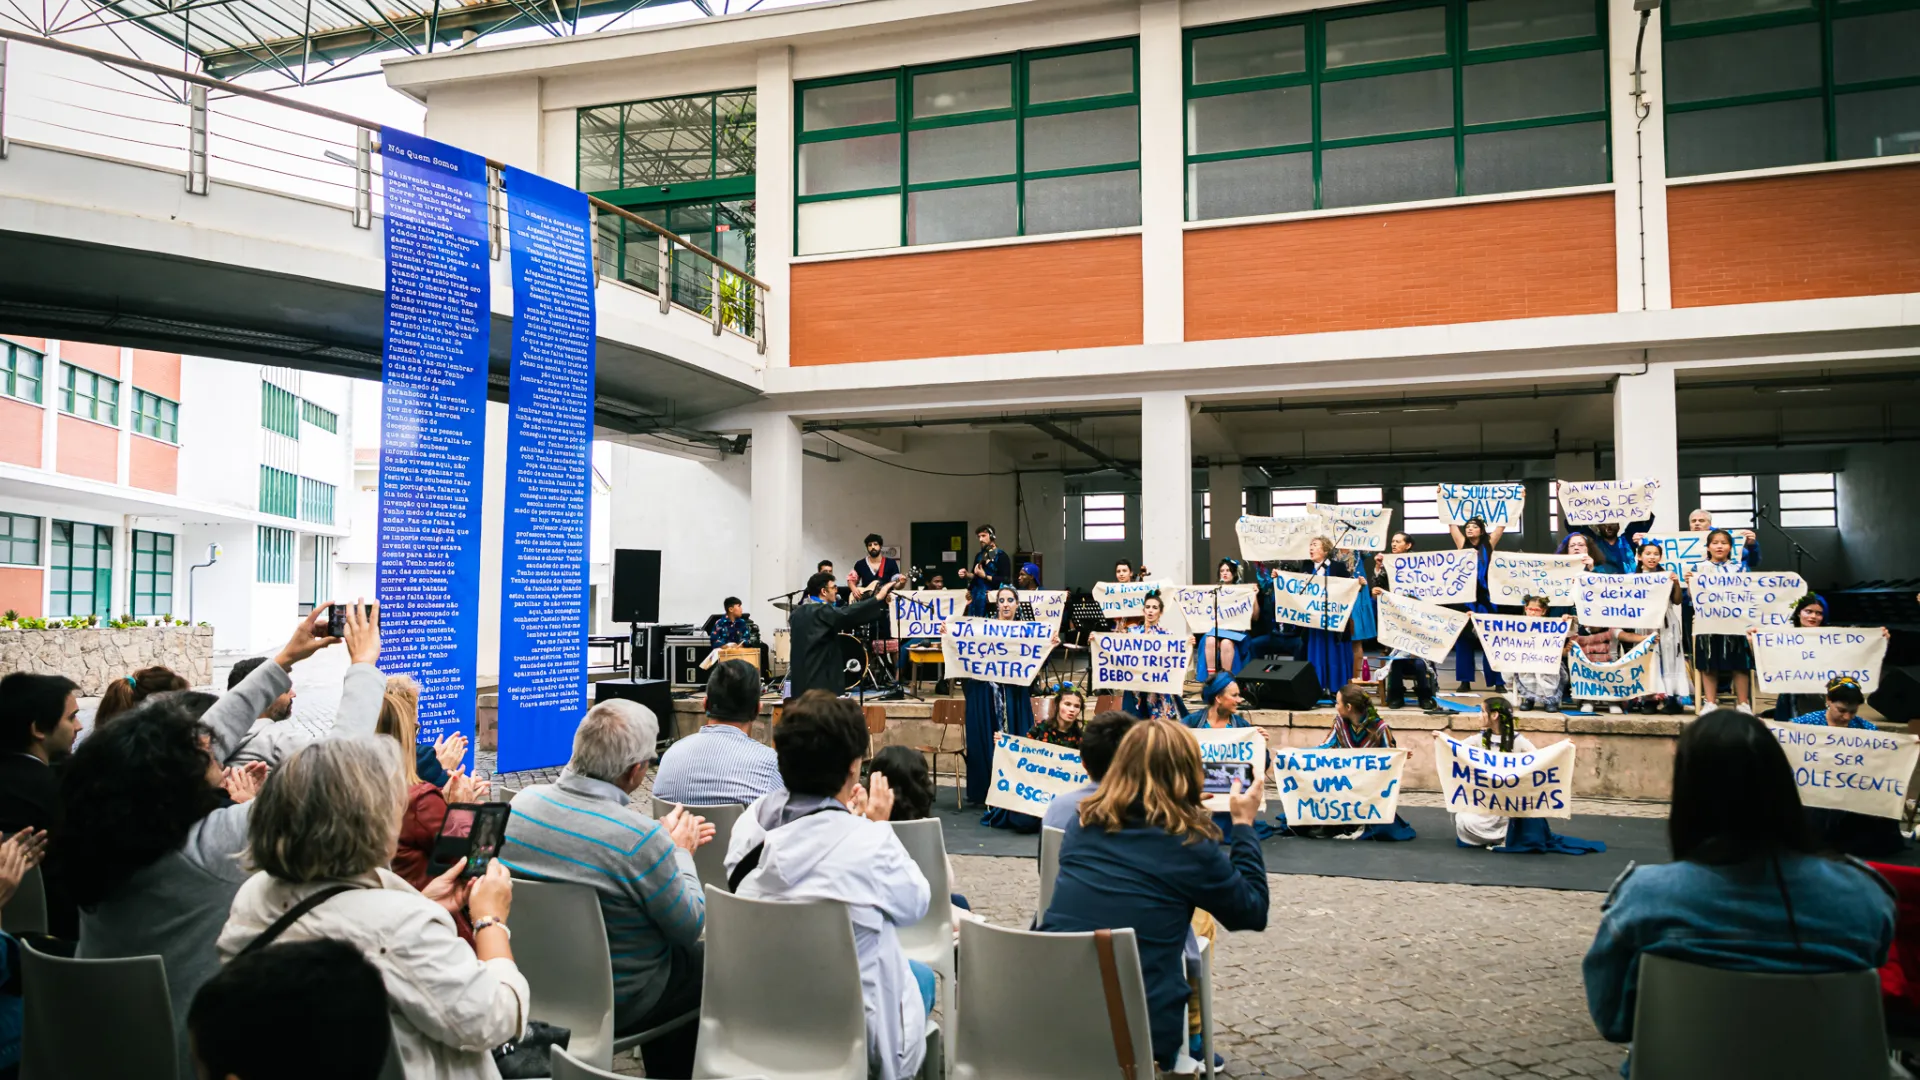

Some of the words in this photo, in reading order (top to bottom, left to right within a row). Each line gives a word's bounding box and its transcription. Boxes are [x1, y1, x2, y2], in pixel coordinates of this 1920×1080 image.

[388, 143, 405, 156] Nós
[406, 149, 431, 163] Quem
[432, 157, 459, 172] Somos
[400, 173, 429, 187] inventei
[431, 182, 446, 191] uma
[464, 191, 473, 199] de
[412, 184, 433, 196] Tenho
[434, 190, 452, 201] medo
[453, 195, 461, 203] de
[391, 252, 422, 264] inventei
[422, 258, 448, 270] formas
[448, 264, 457, 272] de
[385, 455, 393, 463] Se
[394, 457, 408, 465] não
[408, 459, 435, 467] vivesse
[453, 462, 466, 470] não
[384, 481, 398, 490] bem
[437, 485, 461, 494] falaria
[1442, 483, 1460, 500] SE
[1568, 496, 1610, 507] FORMAS
[1619, 494, 1638, 505] DE
[1447, 500, 1508, 523] VOAVA
[1631, 506, 1644, 518] AS
[382, 550, 405, 558] doente
[424, 551, 437, 559] não
[1394, 552, 1455, 570] QUANDO
[1494, 557, 1547, 569] QUANDO
[446, 568, 456, 576] de
[1395, 568, 1435, 584] ESTOU
[1510, 570, 1547, 578] SINTO
[1276, 575, 1285, 591] O
[1533, 578, 1573, 587] TRIST
[1697, 574, 1752, 589] QUANDO
[1600, 586, 1649, 599] deixar
[1696, 590, 1757, 605] CONTENTE
[1763, 592, 1776, 604] O
[1601, 603, 1645, 618] andar
[1694, 606, 1742, 618] MUNDO
[1760, 612, 1794, 626] LEV
[952, 618, 975, 638] JÁ
[1530, 620, 1569, 634] MEDO
[1100, 636, 1162, 653] QUANDO
[1168, 640, 1186, 653] ME
[1492, 634, 1536, 649] AMANHÃ
[1755, 633, 1805, 648] TENHO
[1819, 633, 1866, 645] MEDO
[956, 641, 1008, 658] PEÇAS
[1020, 643, 1043, 659] DE
[1503, 651, 1517, 662] OS
[1801, 650, 1816, 660] DE
[1098, 652, 1139, 667] SINTO
[1142, 655, 1187, 669] TRISTE
[1100, 667, 1133, 682] BEBO
[1142, 670, 1170, 683] CHÁ
[1570, 661, 1625, 684] ABRAÇOS
[1630, 664, 1645, 681] DA
[1571, 681, 1611, 697] MINHA
[997, 734, 1020, 752] Já
[1825, 733, 1899, 751] SAUDADES
[1446, 738, 1535, 769] TENHO
[1804, 751, 1819, 762] DE
[1834, 752, 1865, 767] SER
[1275, 754, 1300, 771] JÁ
[1302, 753, 1393, 771] INVENTEI
[1313, 775, 1353, 793] UMA
[1452, 763, 1520, 789] MEDO
[1533, 767, 1561, 788] DE
[1791, 767, 1905, 797] OLESCENTE
[1450, 784, 1565, 813] ARANHAS
[1297, 796, 1383, 822] MÚSICA
